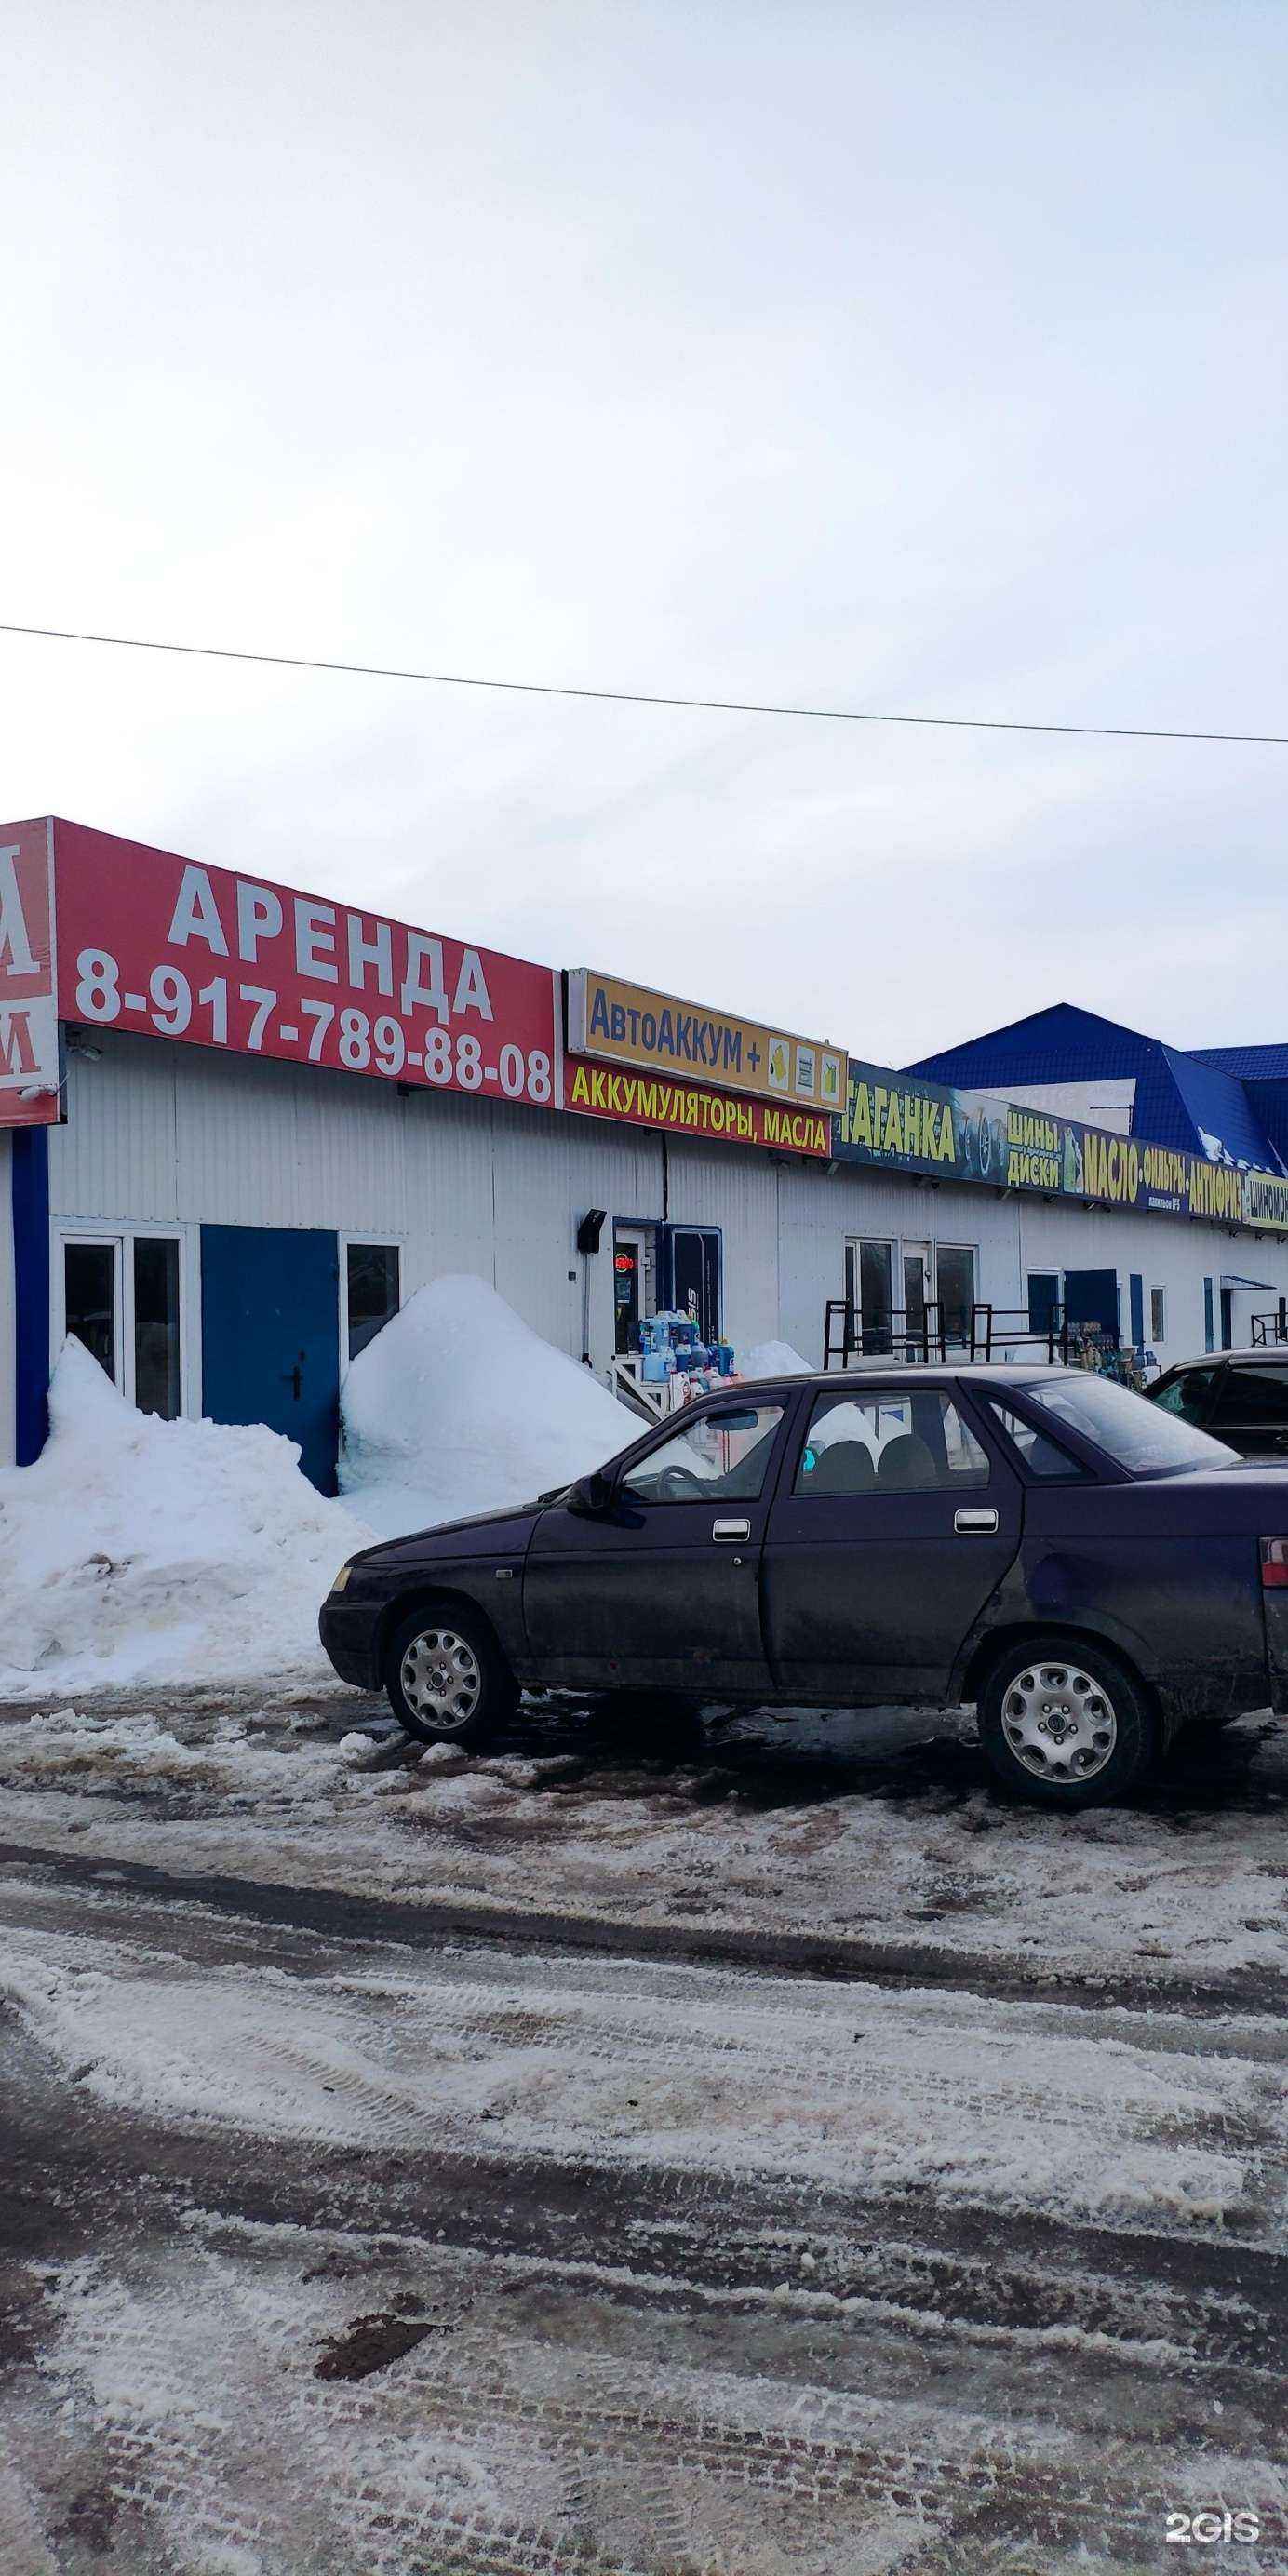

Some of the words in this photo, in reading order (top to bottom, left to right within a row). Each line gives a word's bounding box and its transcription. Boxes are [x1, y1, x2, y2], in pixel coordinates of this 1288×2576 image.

[168, 865, 493, 1025] АРЕНДА
[75, 947, 552, 1103] 8-917-789-88-08
[571, 1067, 758, 1143] АККУМУЛЯТОРЫ,
[763, 1109, 826, 1150] МАСЛА
[1007, 1111, 1058, 1152] ШИНЫ
[1007, 1151, 1058, 1187] ДИСКИ
[1084, 1133, 1138, 1203] МАСЛО
[1144, 1146, 1186, 1194] ФИЛЬТРЫ
[1189, 1161, 1241, 1221] АНТИФРИЗ
